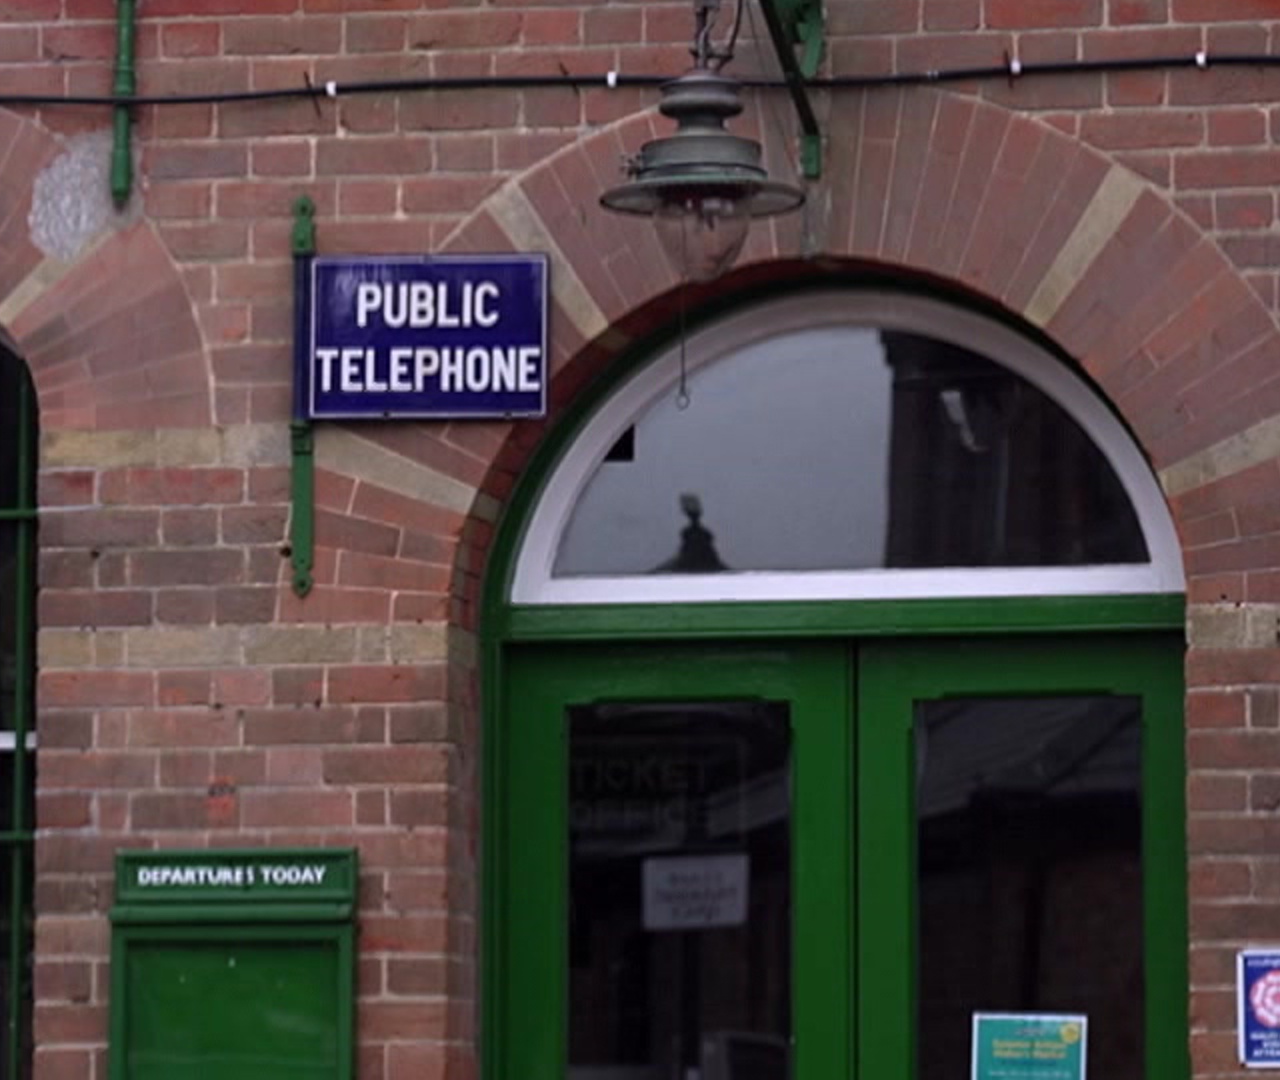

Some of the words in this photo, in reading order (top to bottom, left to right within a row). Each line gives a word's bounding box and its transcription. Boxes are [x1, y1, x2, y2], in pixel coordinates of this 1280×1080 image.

[357, 280, 500, 328] PUBLIC
[316, 345, 541, 393] TELEPHONE
[137, 866, 255, 886] DEPARTURES
[260, 865, 327, 885] TODAY
